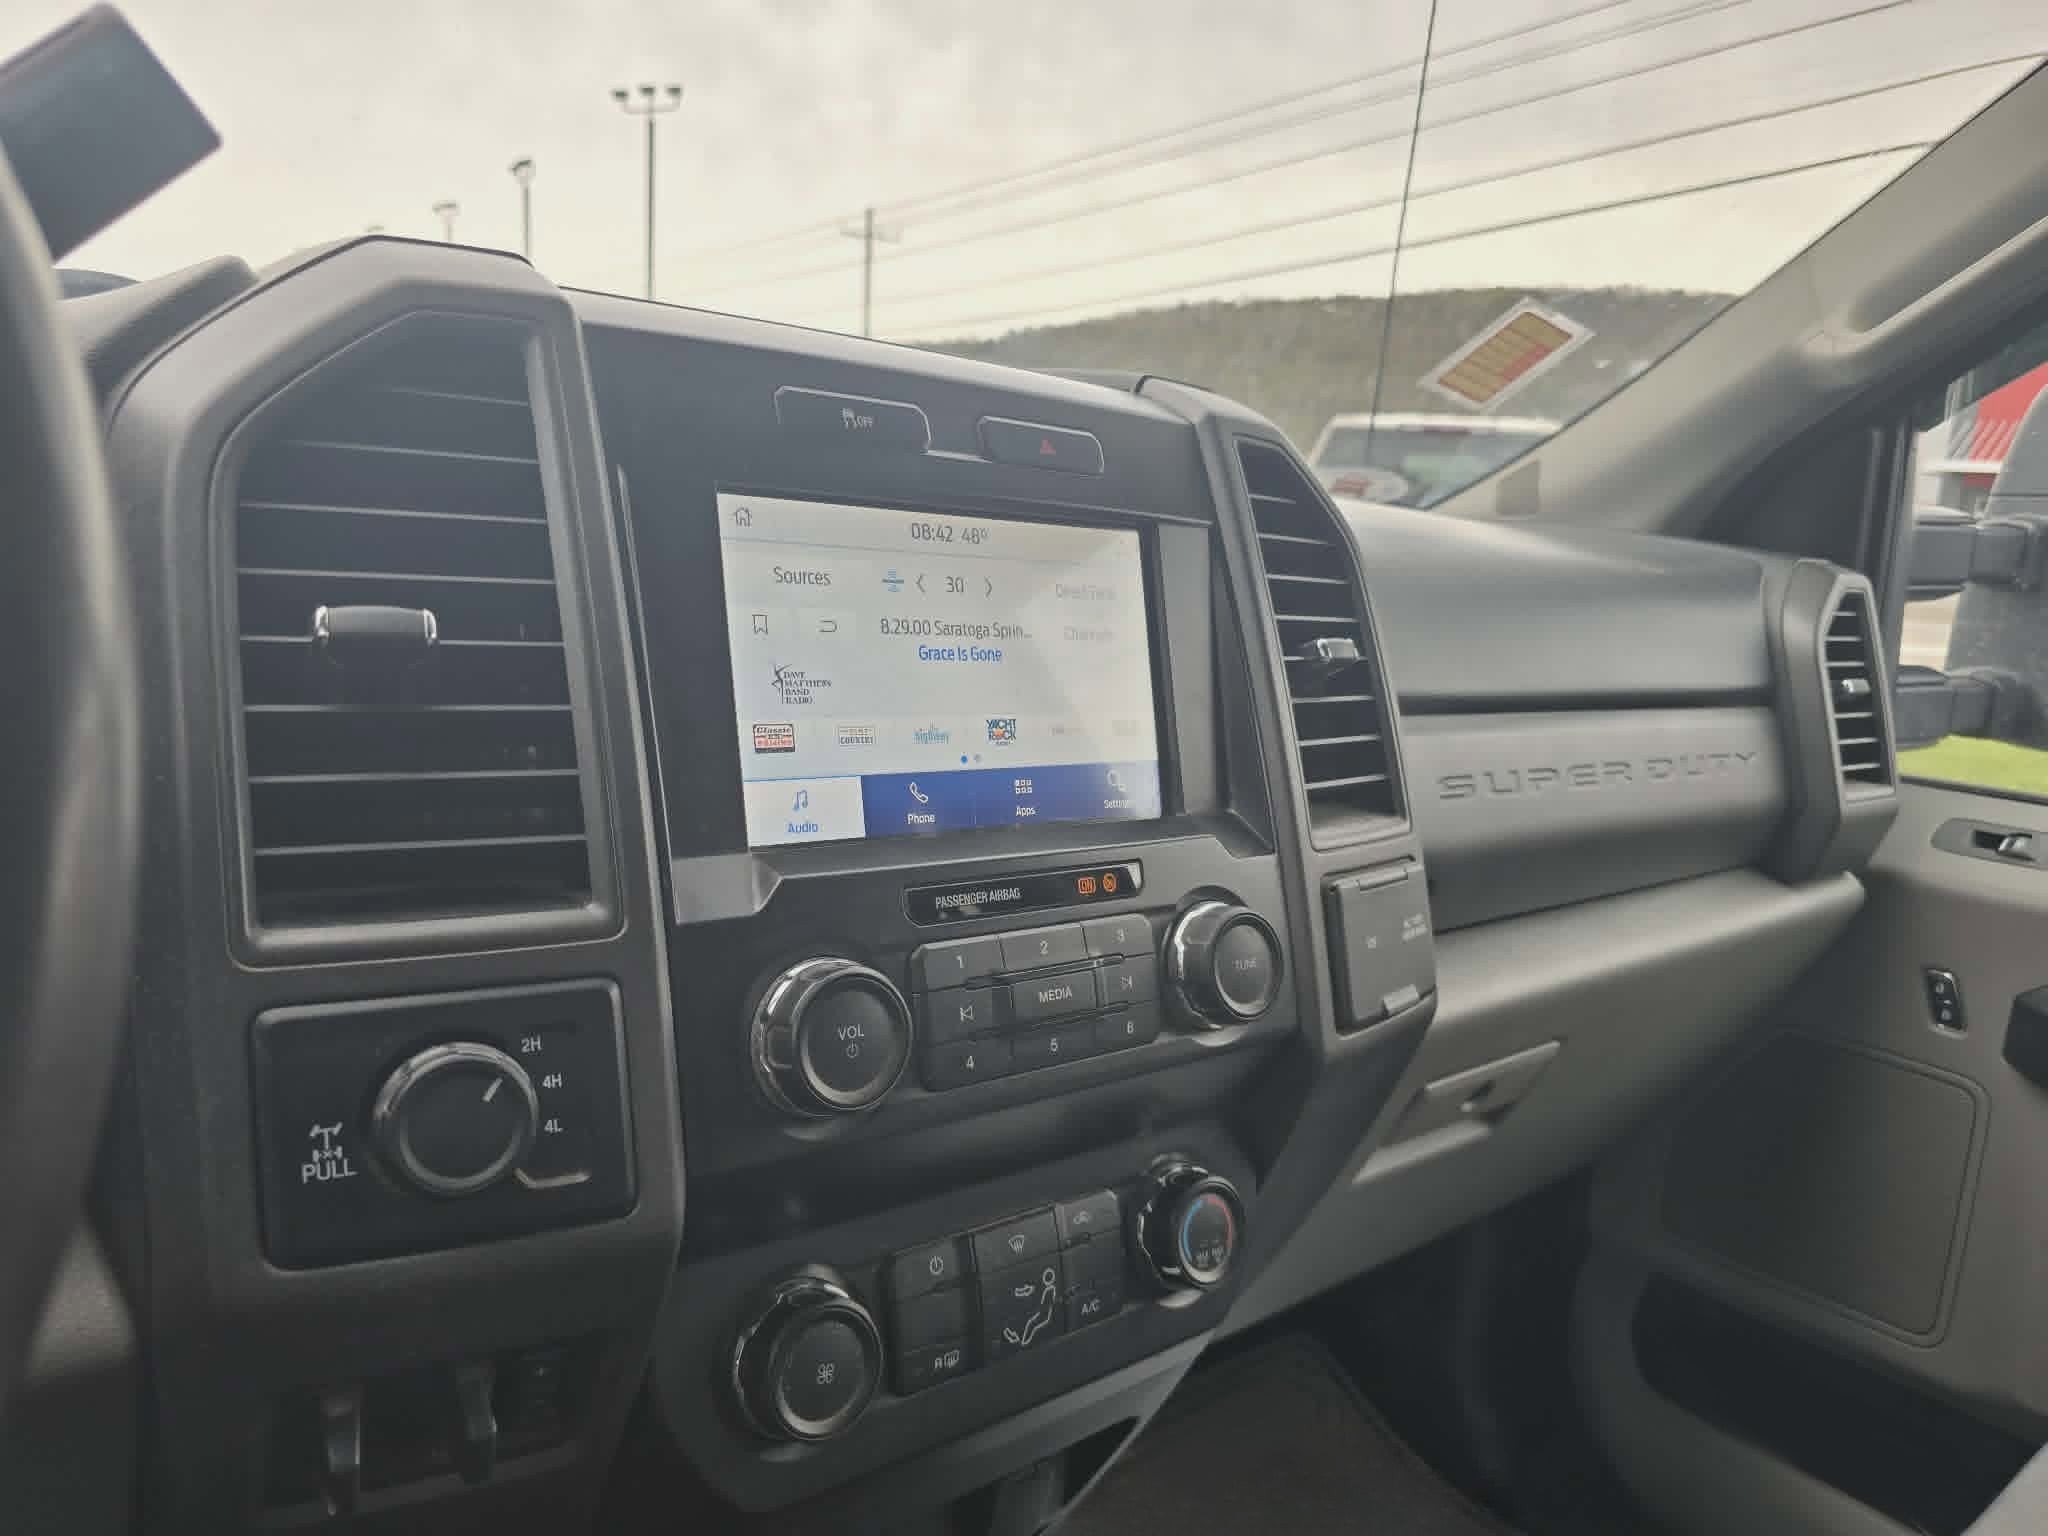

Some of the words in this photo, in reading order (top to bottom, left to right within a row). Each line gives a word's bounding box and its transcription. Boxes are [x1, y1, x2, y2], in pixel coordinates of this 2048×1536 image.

[911, 522, 953, 542] 08:42
[773, 566, 831, 586] Sources
[881, 618, 931, 635] 8.29.00
[934, 621, 990, 640] Saratoga
[919, 645, 954, 662] Grace
[958, 646, 968, 662] Is
[971, 646, 1002, 662] Gone
[785, 688, 810, 696] BAND
[986, 719, 1017, 729] YACHT
[1436, 759, 1634, 800] SUPER
[907, 811, 936, 825] Phone
[1015, 804, 1036, 818] Apps
[787, 820, 819, 834] Audio
[935, 891, 988, 909] PASSENGER
[989, 887, 1021, 901] AIRBAG
[1115, 928, 1125, 942] 3
[1039, 940, 1049, 955] 2
[956, 954, 965, 970] 1
[1038, 986, 1074, 1003] MEDIA
[838, 1023, 865, 1041] VOL
[520, 1035, 542, 1053] 2H
[966, 1055, 975, 1071] 4
[542, 1073, 563, 1090] 4H
[543, 1118, 563, 1134] 4L
[301, 1159, 357, 1184] PULL
